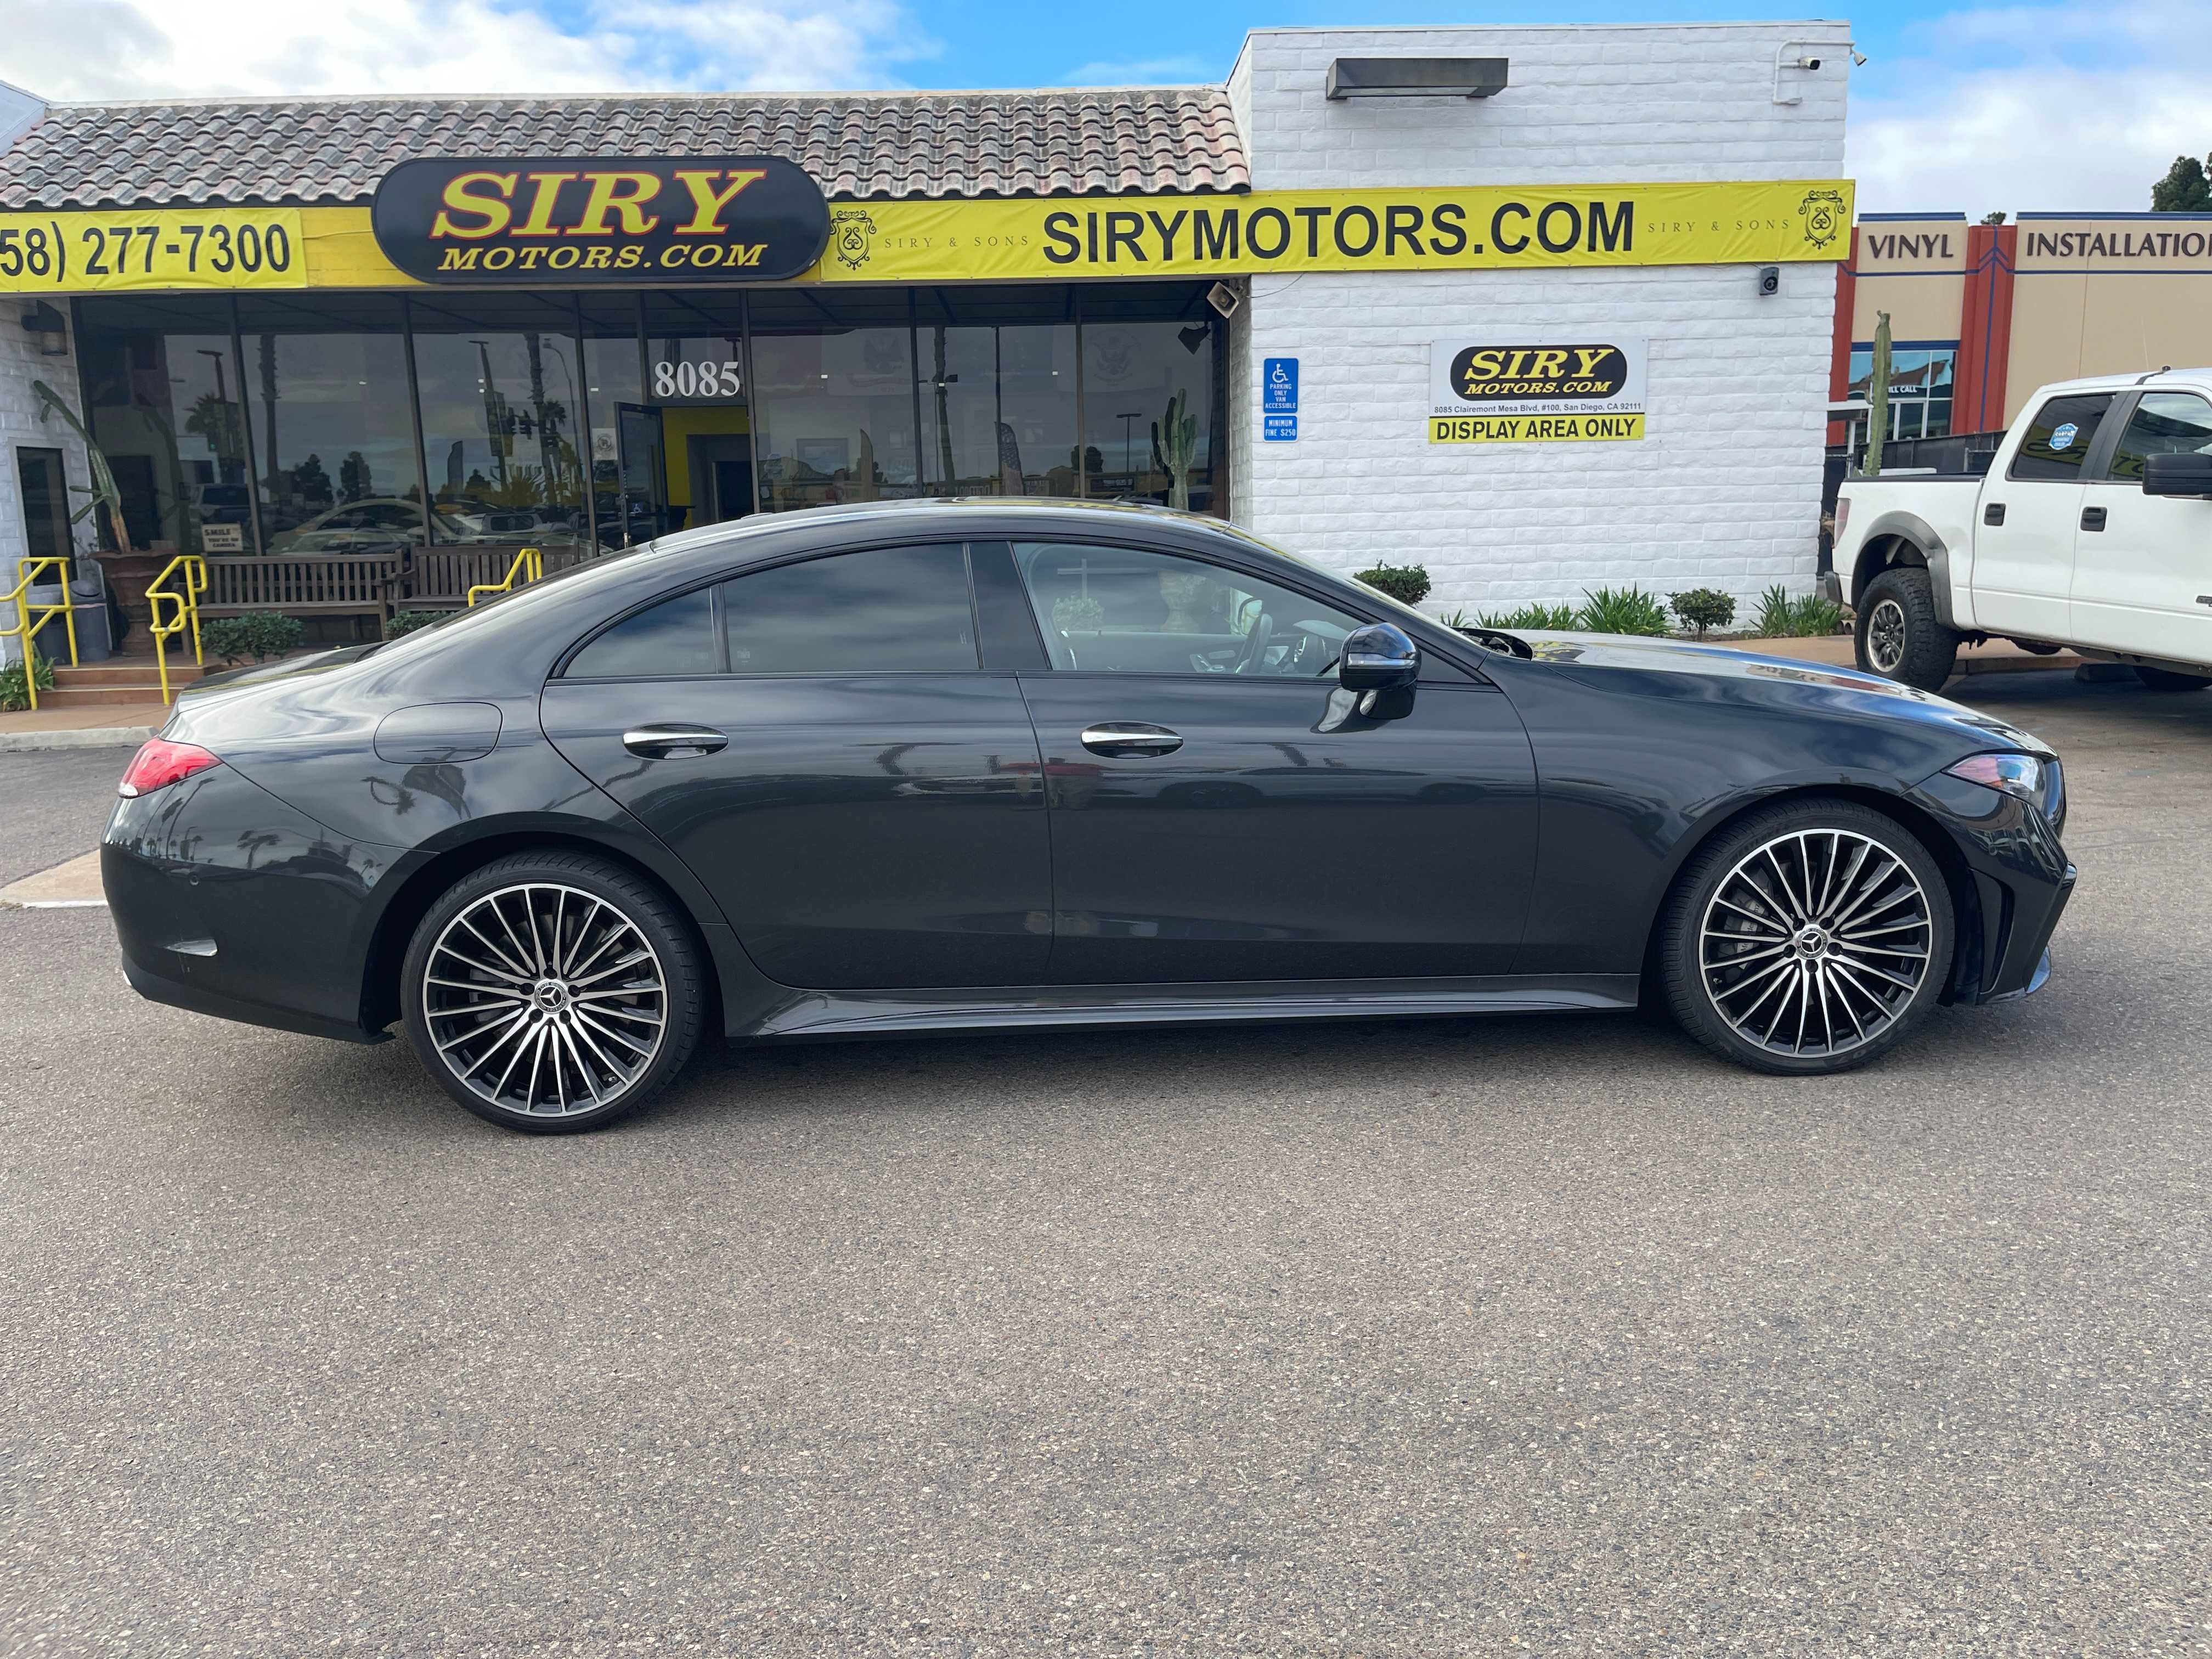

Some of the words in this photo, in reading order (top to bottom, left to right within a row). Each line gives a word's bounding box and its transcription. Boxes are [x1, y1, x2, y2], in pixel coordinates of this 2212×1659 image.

[430, 169, 768, 240] SIRY
[1042, 201, 1634, 264] SIRYMOTORS.COM
[1648, 222, 1696, 233] SIRY
[1711, 221, 1720, 231] &
[1735, 219, 1789, 230] SONS
[0, 221, 65, 283] 58)
[82, 224, 290, 275] 277-7300
[884, 237, 933, 248] SIRY
[949, 238, 957, 247] &
[974, 235, 1028, 247] SONS
[1868, 234, 1954, 258] VINYL
[2027, 232, 2212, 257] INSTALLATIO
[437, 244, 768, 271] MOTORS.COM
[1464, 348, 1615, 380] SIRY
[654, 361, 740, 397] 8085
[1464, 381, 1612, 395] MOTORS.COM
[1581, 403, 1605, 411] Diego,
[1280, 428, 1296, 437] $250
[1437, 421, 1520, 439] DISPLAY
[1525, 420, 1579, 438] AREA
[1585, 419, 1637, 437] ONLY
